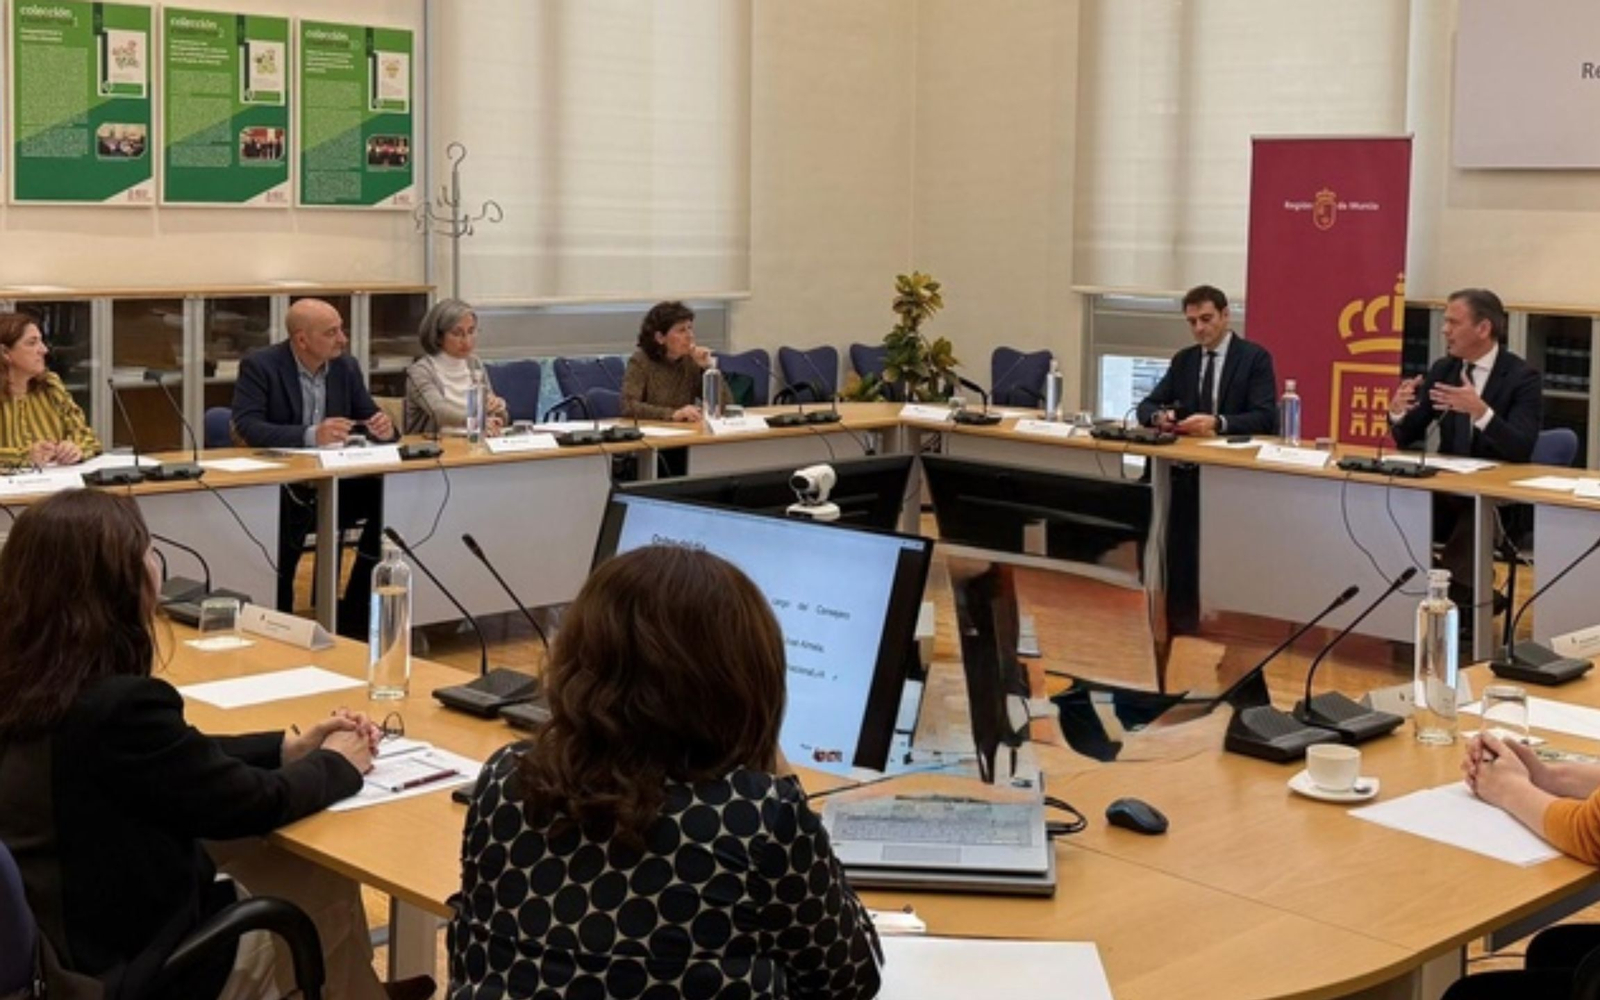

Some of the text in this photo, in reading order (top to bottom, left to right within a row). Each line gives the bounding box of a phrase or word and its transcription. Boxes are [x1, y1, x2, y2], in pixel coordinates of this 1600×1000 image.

[1284, 200, 1379, 212] Región de Murcia
